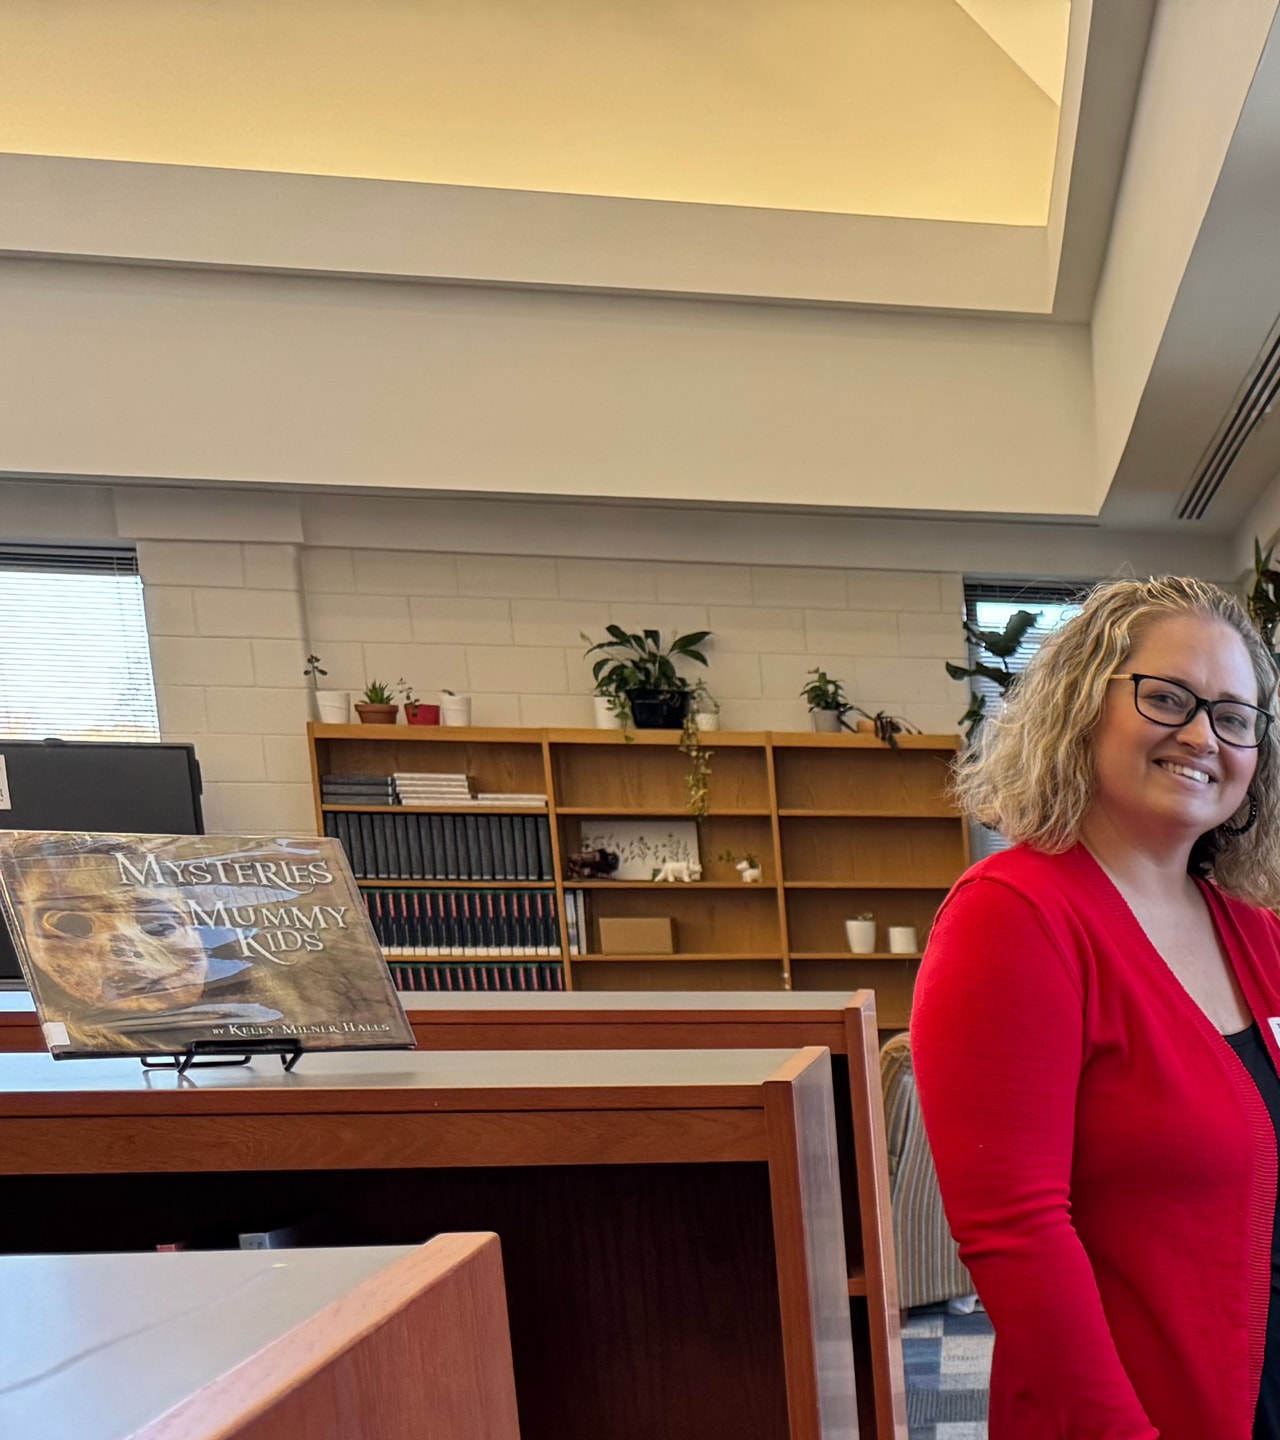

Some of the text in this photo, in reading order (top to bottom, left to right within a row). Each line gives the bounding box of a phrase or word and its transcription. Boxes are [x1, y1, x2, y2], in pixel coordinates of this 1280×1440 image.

[113, 852, 333, 894] MYSTERIES
[185, 900, 349, 930] MUMMY
[235, 926, 325, 965] KIDS
